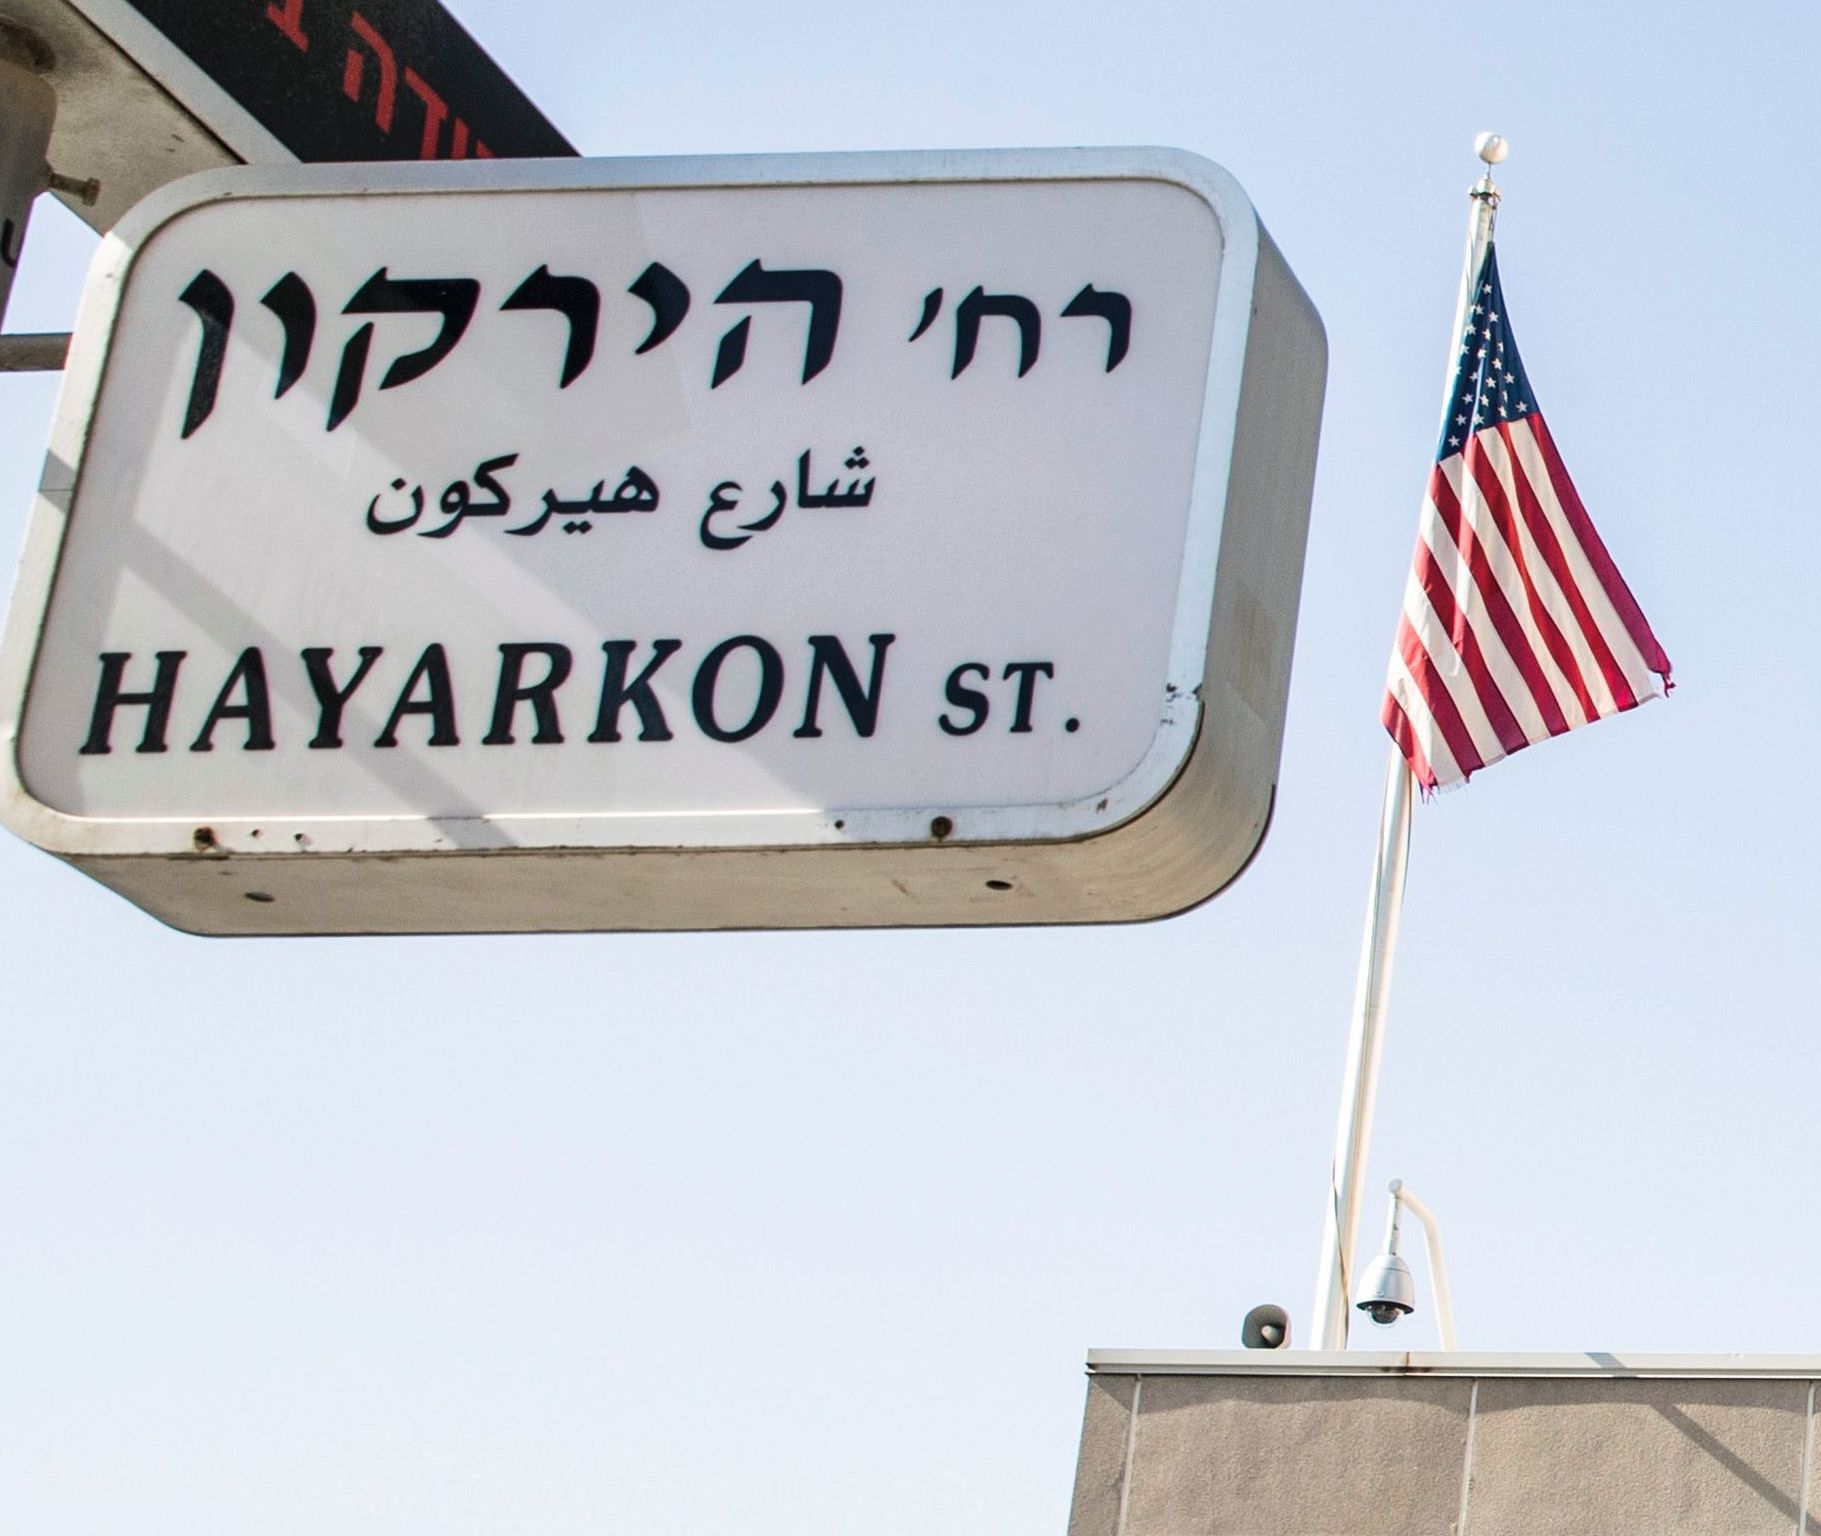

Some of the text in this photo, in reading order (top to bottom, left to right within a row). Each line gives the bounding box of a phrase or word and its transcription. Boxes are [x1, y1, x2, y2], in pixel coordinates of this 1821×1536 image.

[178, 258, 1132, 438] רח' הירקון
[365, 446, 876, 551] شارع هيركون
[79, 633, 1081, 755] HAYARKON ST.
